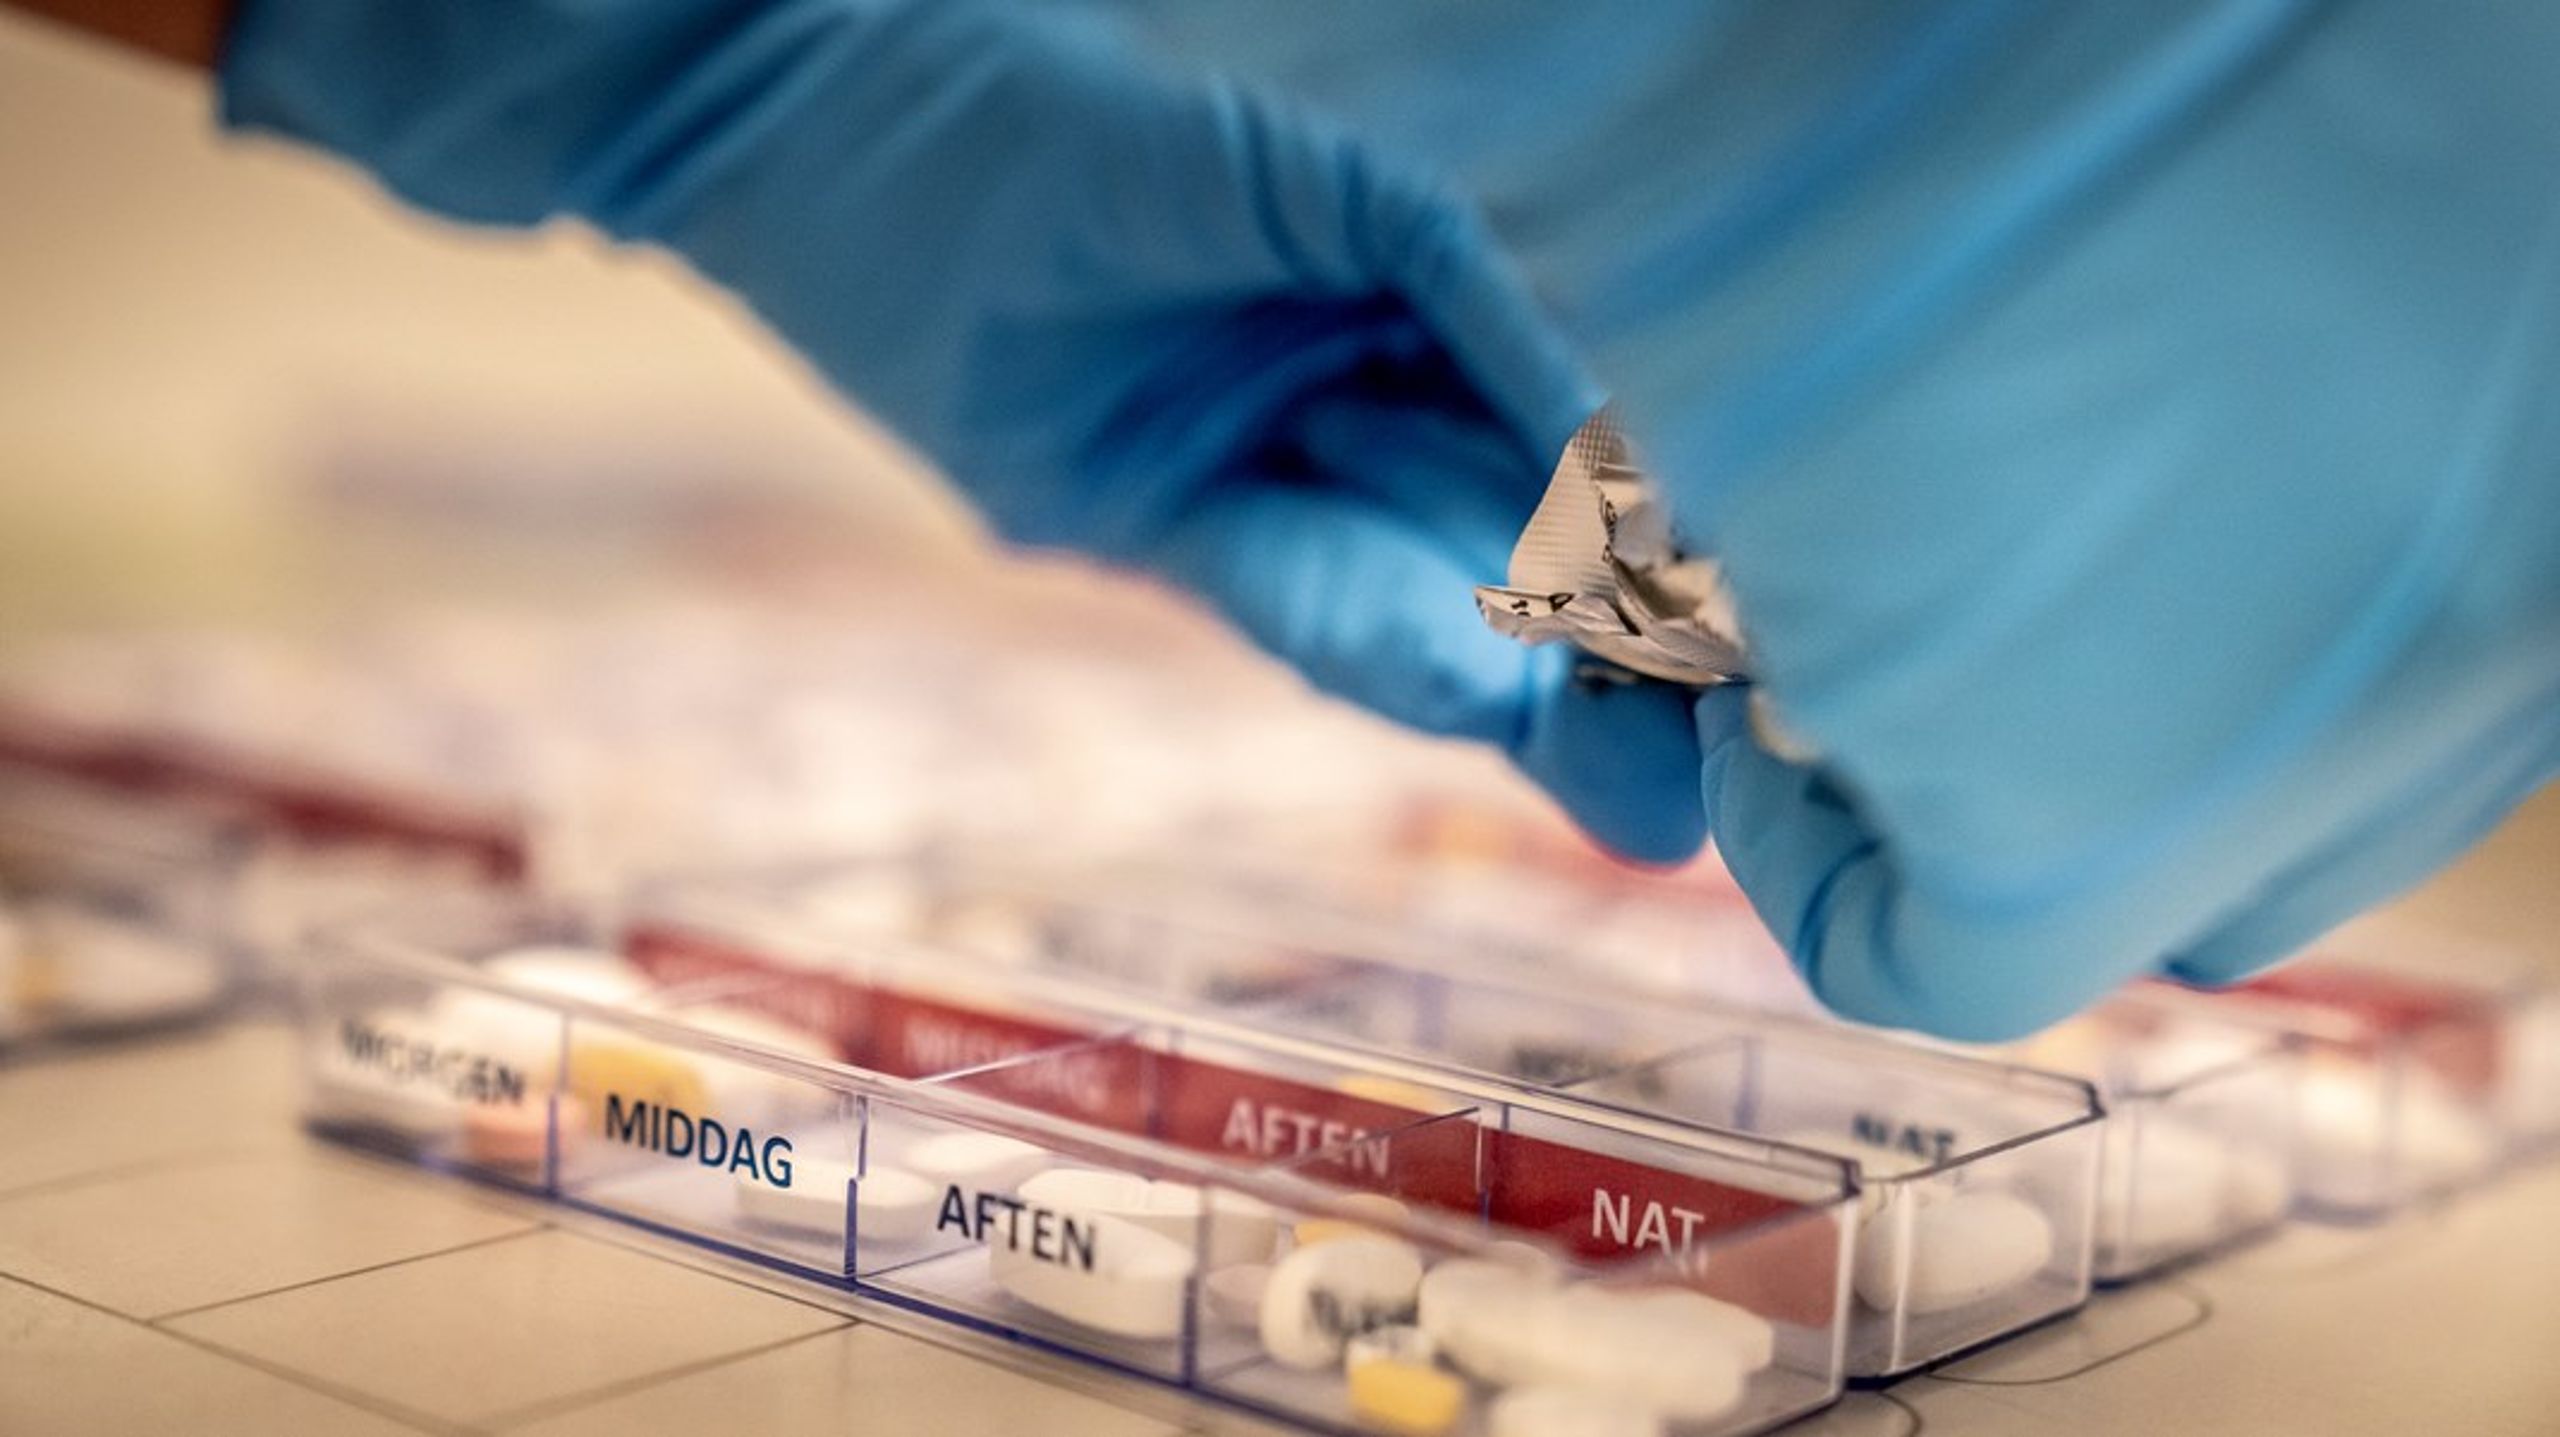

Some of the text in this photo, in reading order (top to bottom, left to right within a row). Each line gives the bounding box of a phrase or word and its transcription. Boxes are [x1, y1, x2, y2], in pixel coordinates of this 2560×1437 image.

[604, 1093, 794, 1188] MIDDAG
[1221, 1098, 1390, 1178] AFTEN
[937, 1184, 1098, 1274] AFTEN
[1592, 1187, 1705, 1257] NAT
